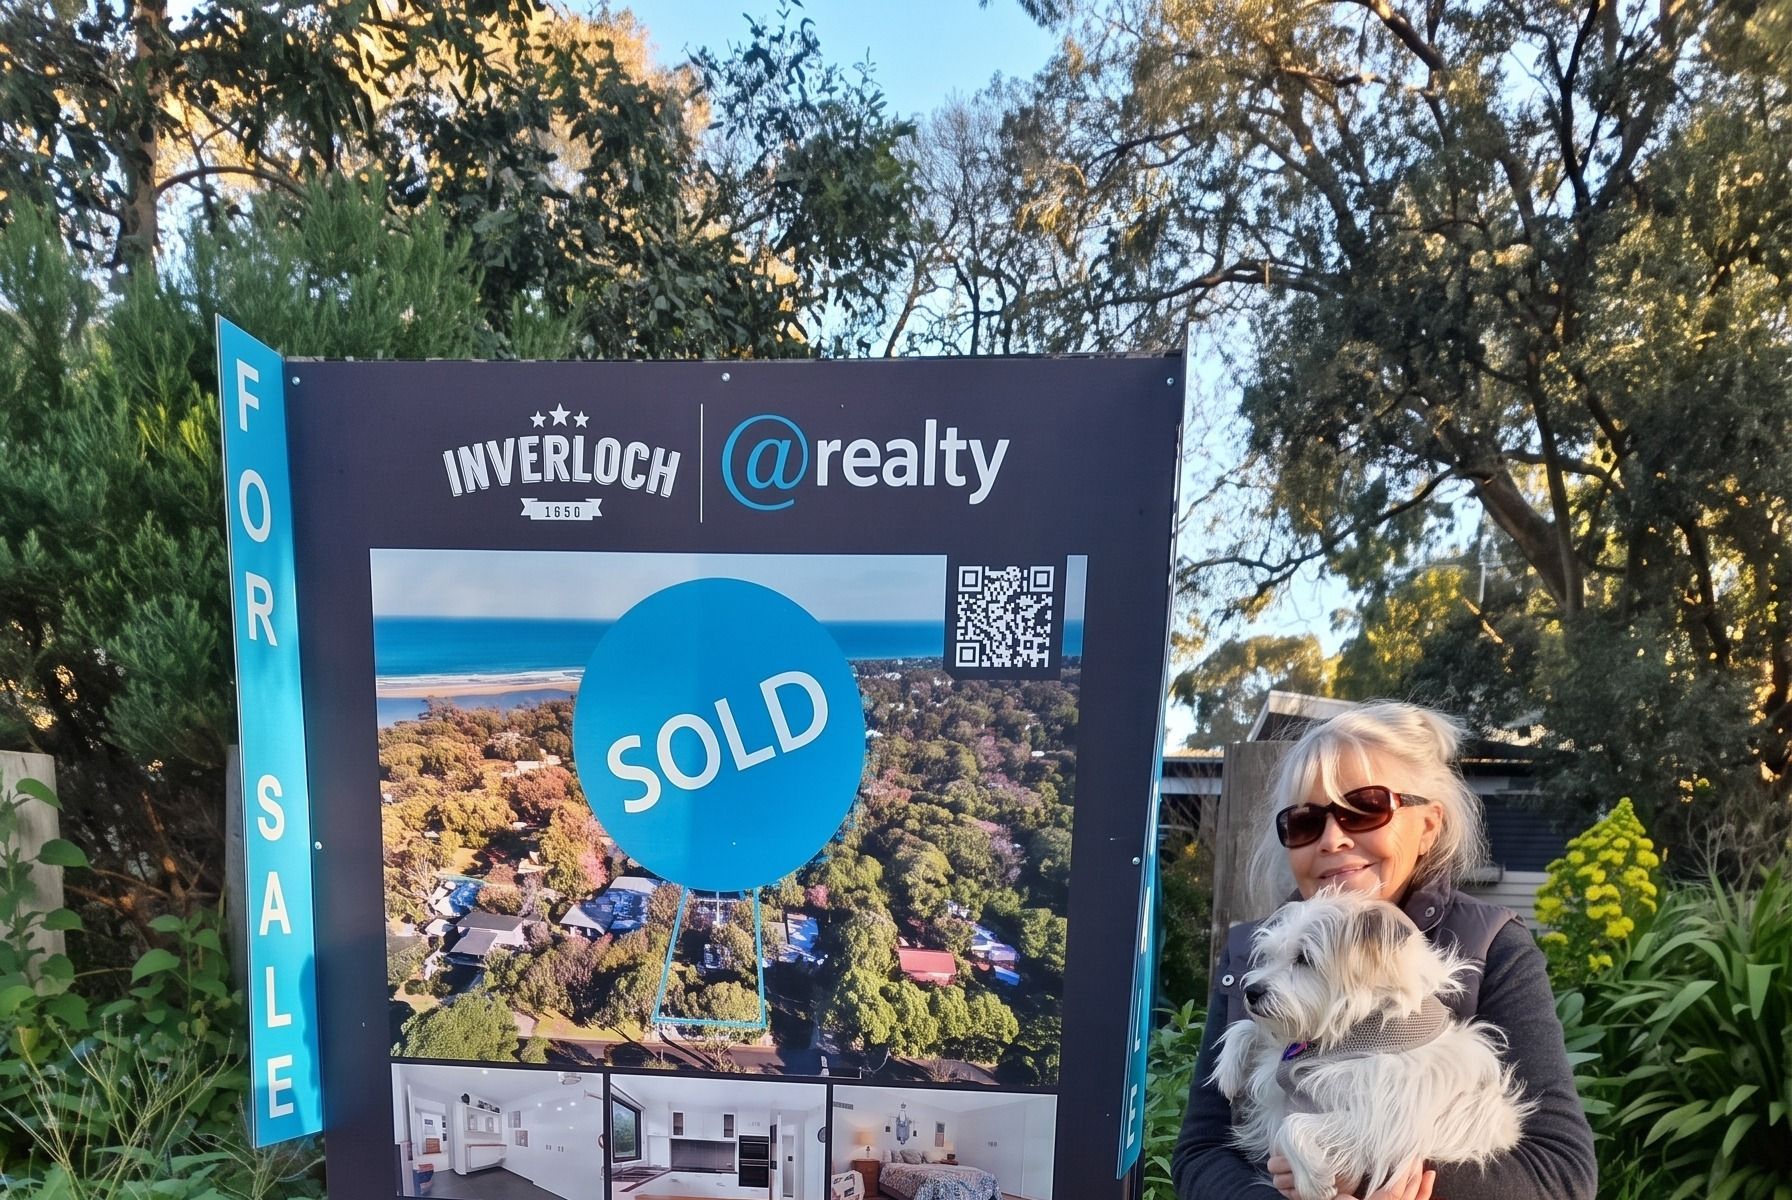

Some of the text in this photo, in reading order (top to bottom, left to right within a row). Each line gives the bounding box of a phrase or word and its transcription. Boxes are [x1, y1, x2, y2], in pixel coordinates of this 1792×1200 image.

[443, 435, 681, 499] INVERLOCH
[722, 415, 1010, 510] @realty
[543, 506, 582, 520] 1650
[236, 359, 294, 1119] FOR SALE
[608, 672, 827, 812] SOLD
